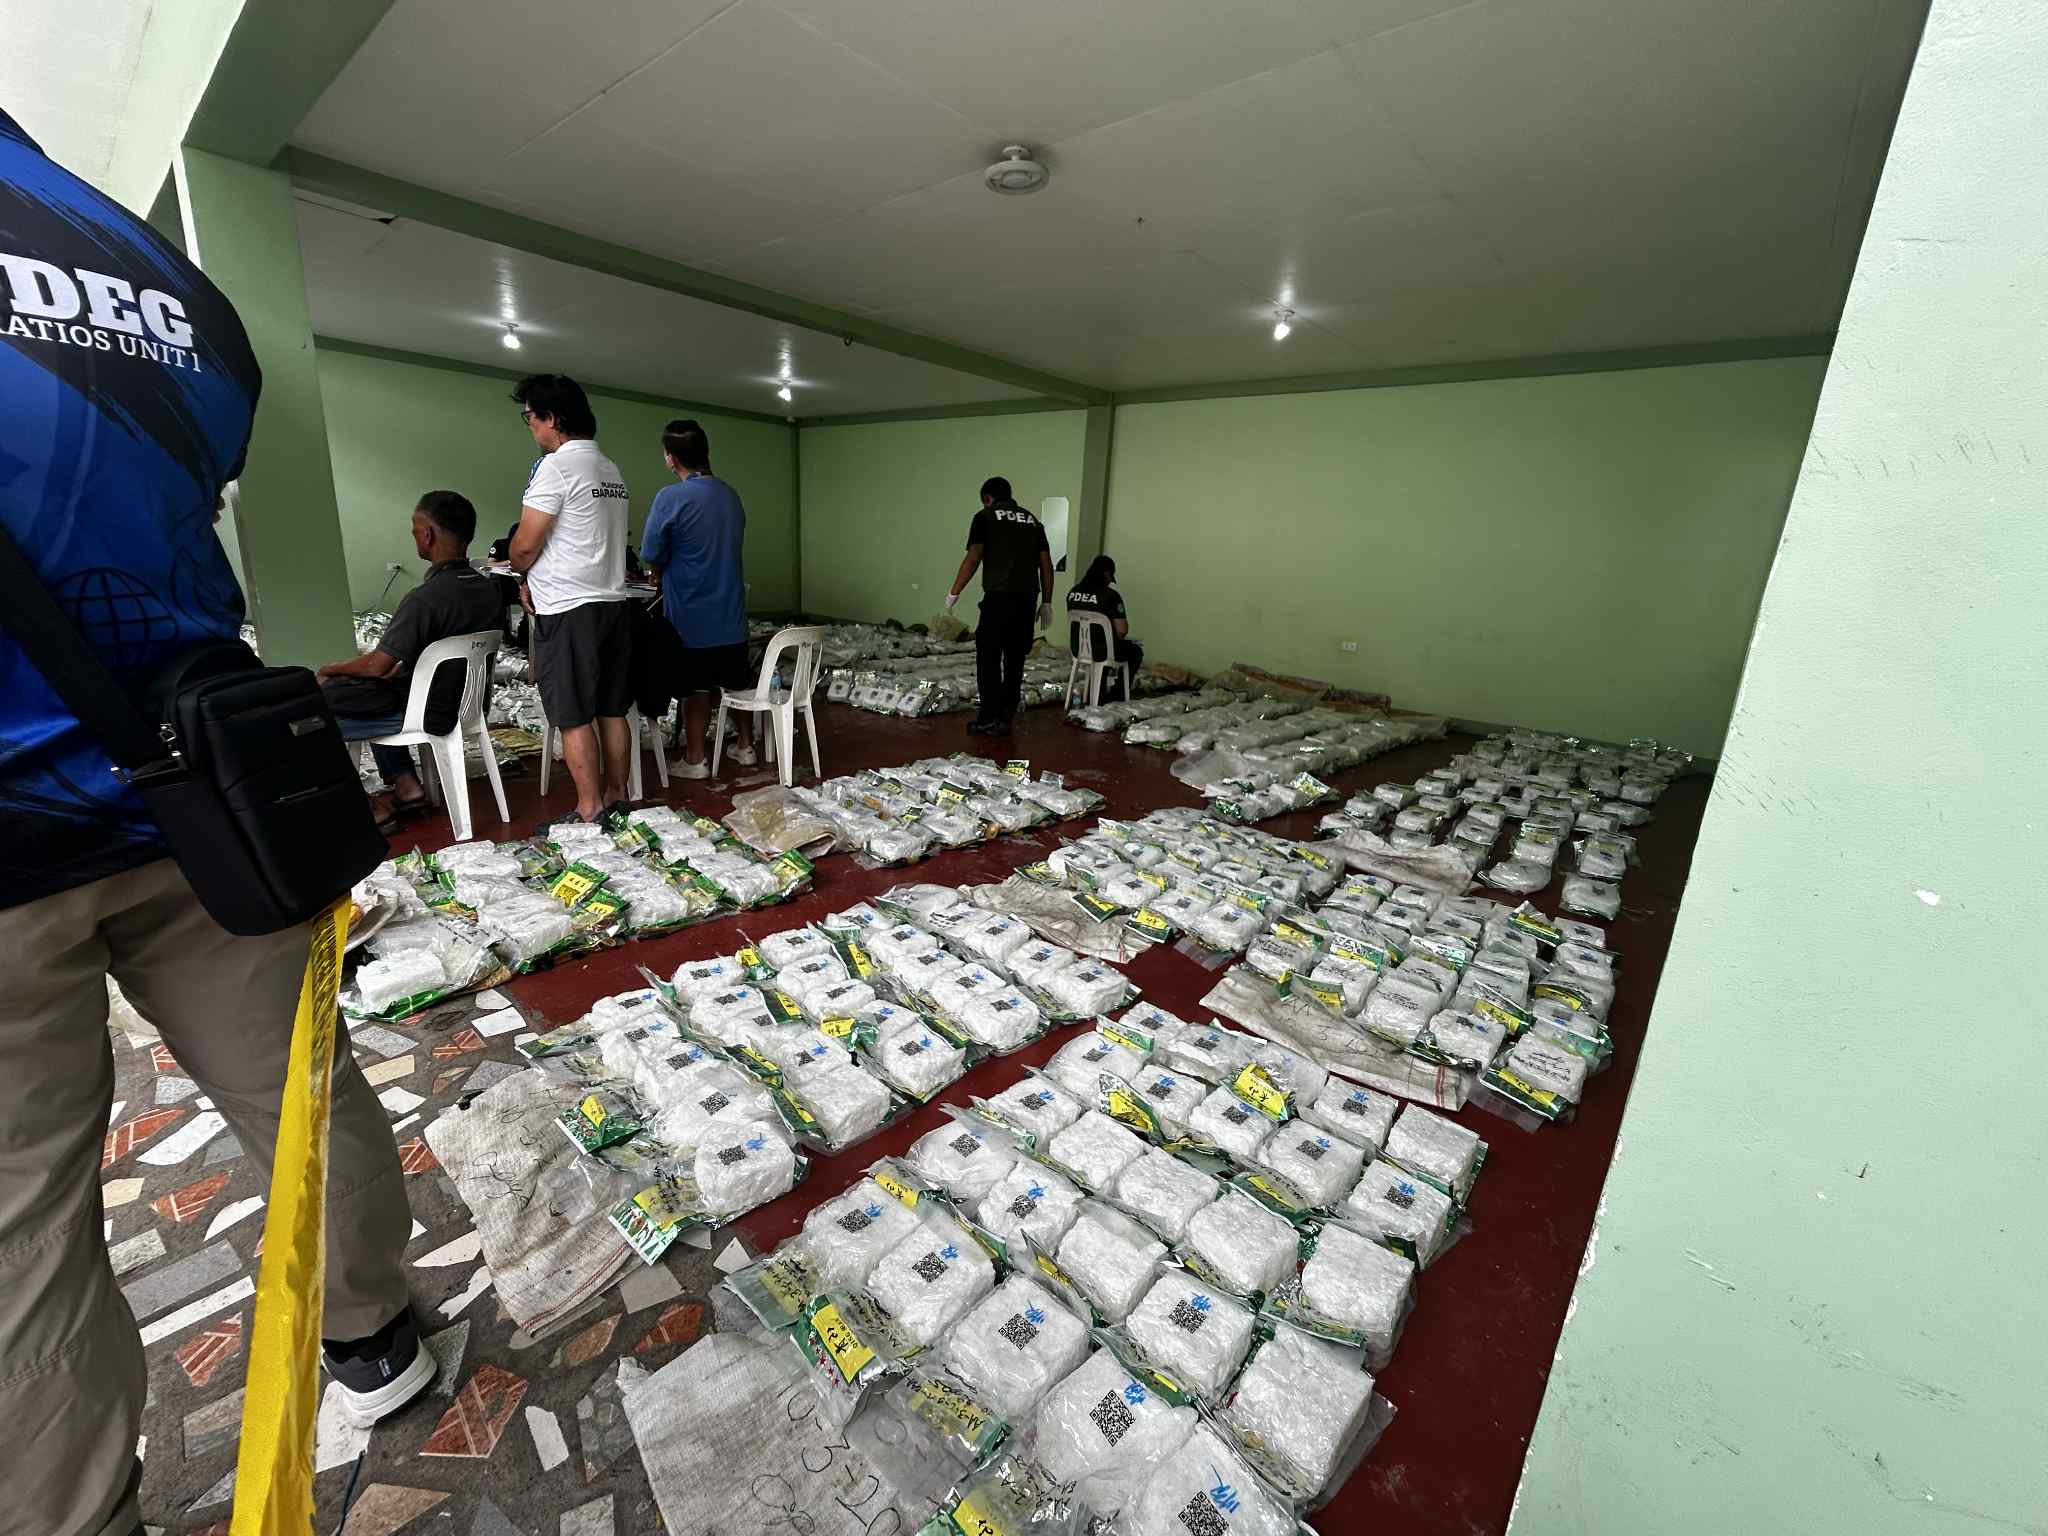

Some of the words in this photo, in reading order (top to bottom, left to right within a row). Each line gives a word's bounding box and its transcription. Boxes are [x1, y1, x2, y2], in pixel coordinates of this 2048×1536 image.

[0, 315, 111, 351] ATIOS
[116, 334, 187, 368] UNIT
[994, 509, 1037, 527] PDEA
[1068, 591, 1098, 605] PDEA
